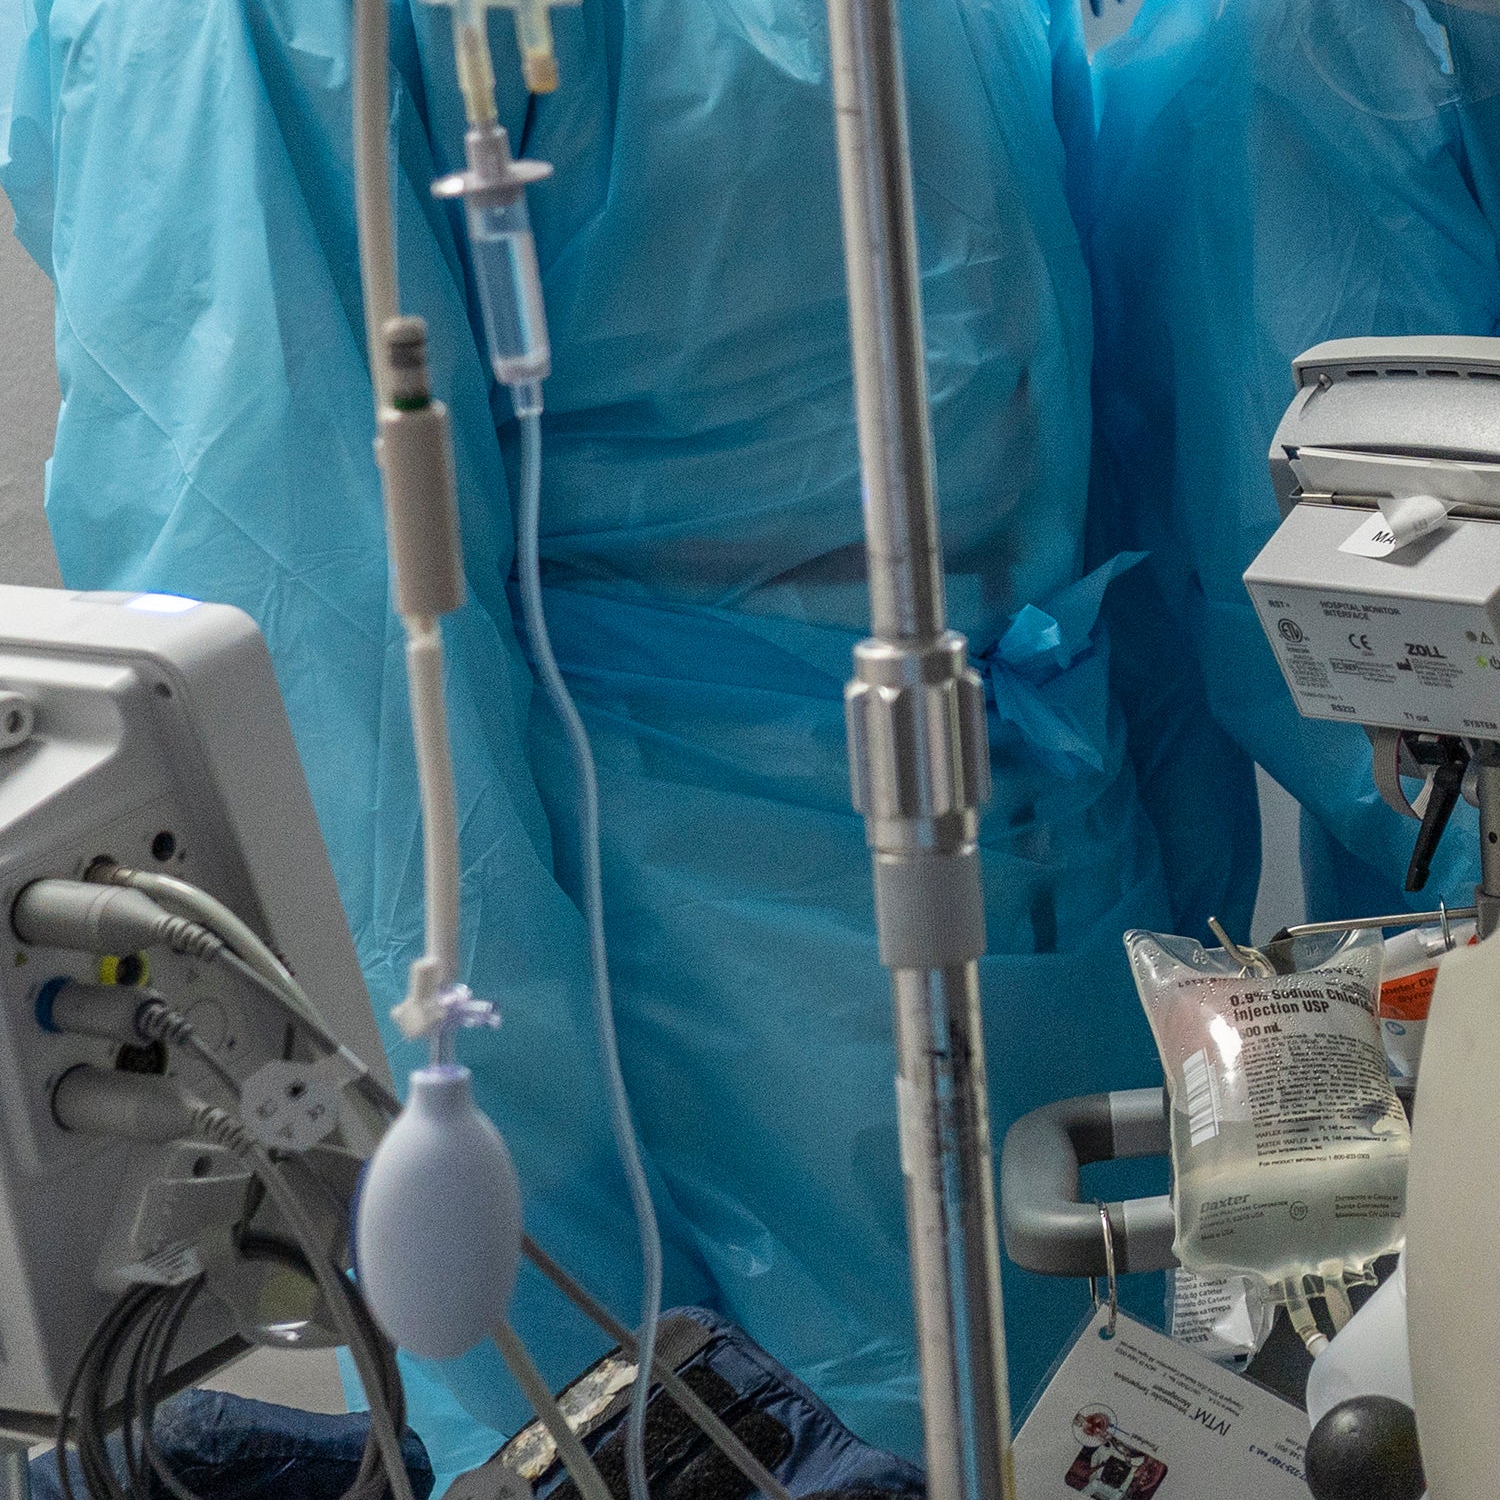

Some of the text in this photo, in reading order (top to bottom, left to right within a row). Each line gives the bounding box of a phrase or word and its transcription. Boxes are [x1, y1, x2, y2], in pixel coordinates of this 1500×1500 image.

[1371, 530, 1396, 545] MA
[1405, 643, 1447, 659] ZOLL
[1463, 719, 1498, 731] SYSTEM
[1230, 992, 1269, 1008] 0.9%
[1271, 988, 1325, 1001] Sodium
[1233, 1000, 1330, 1022] Injection USP
[1264, 1022, 1282, 1036] mL
